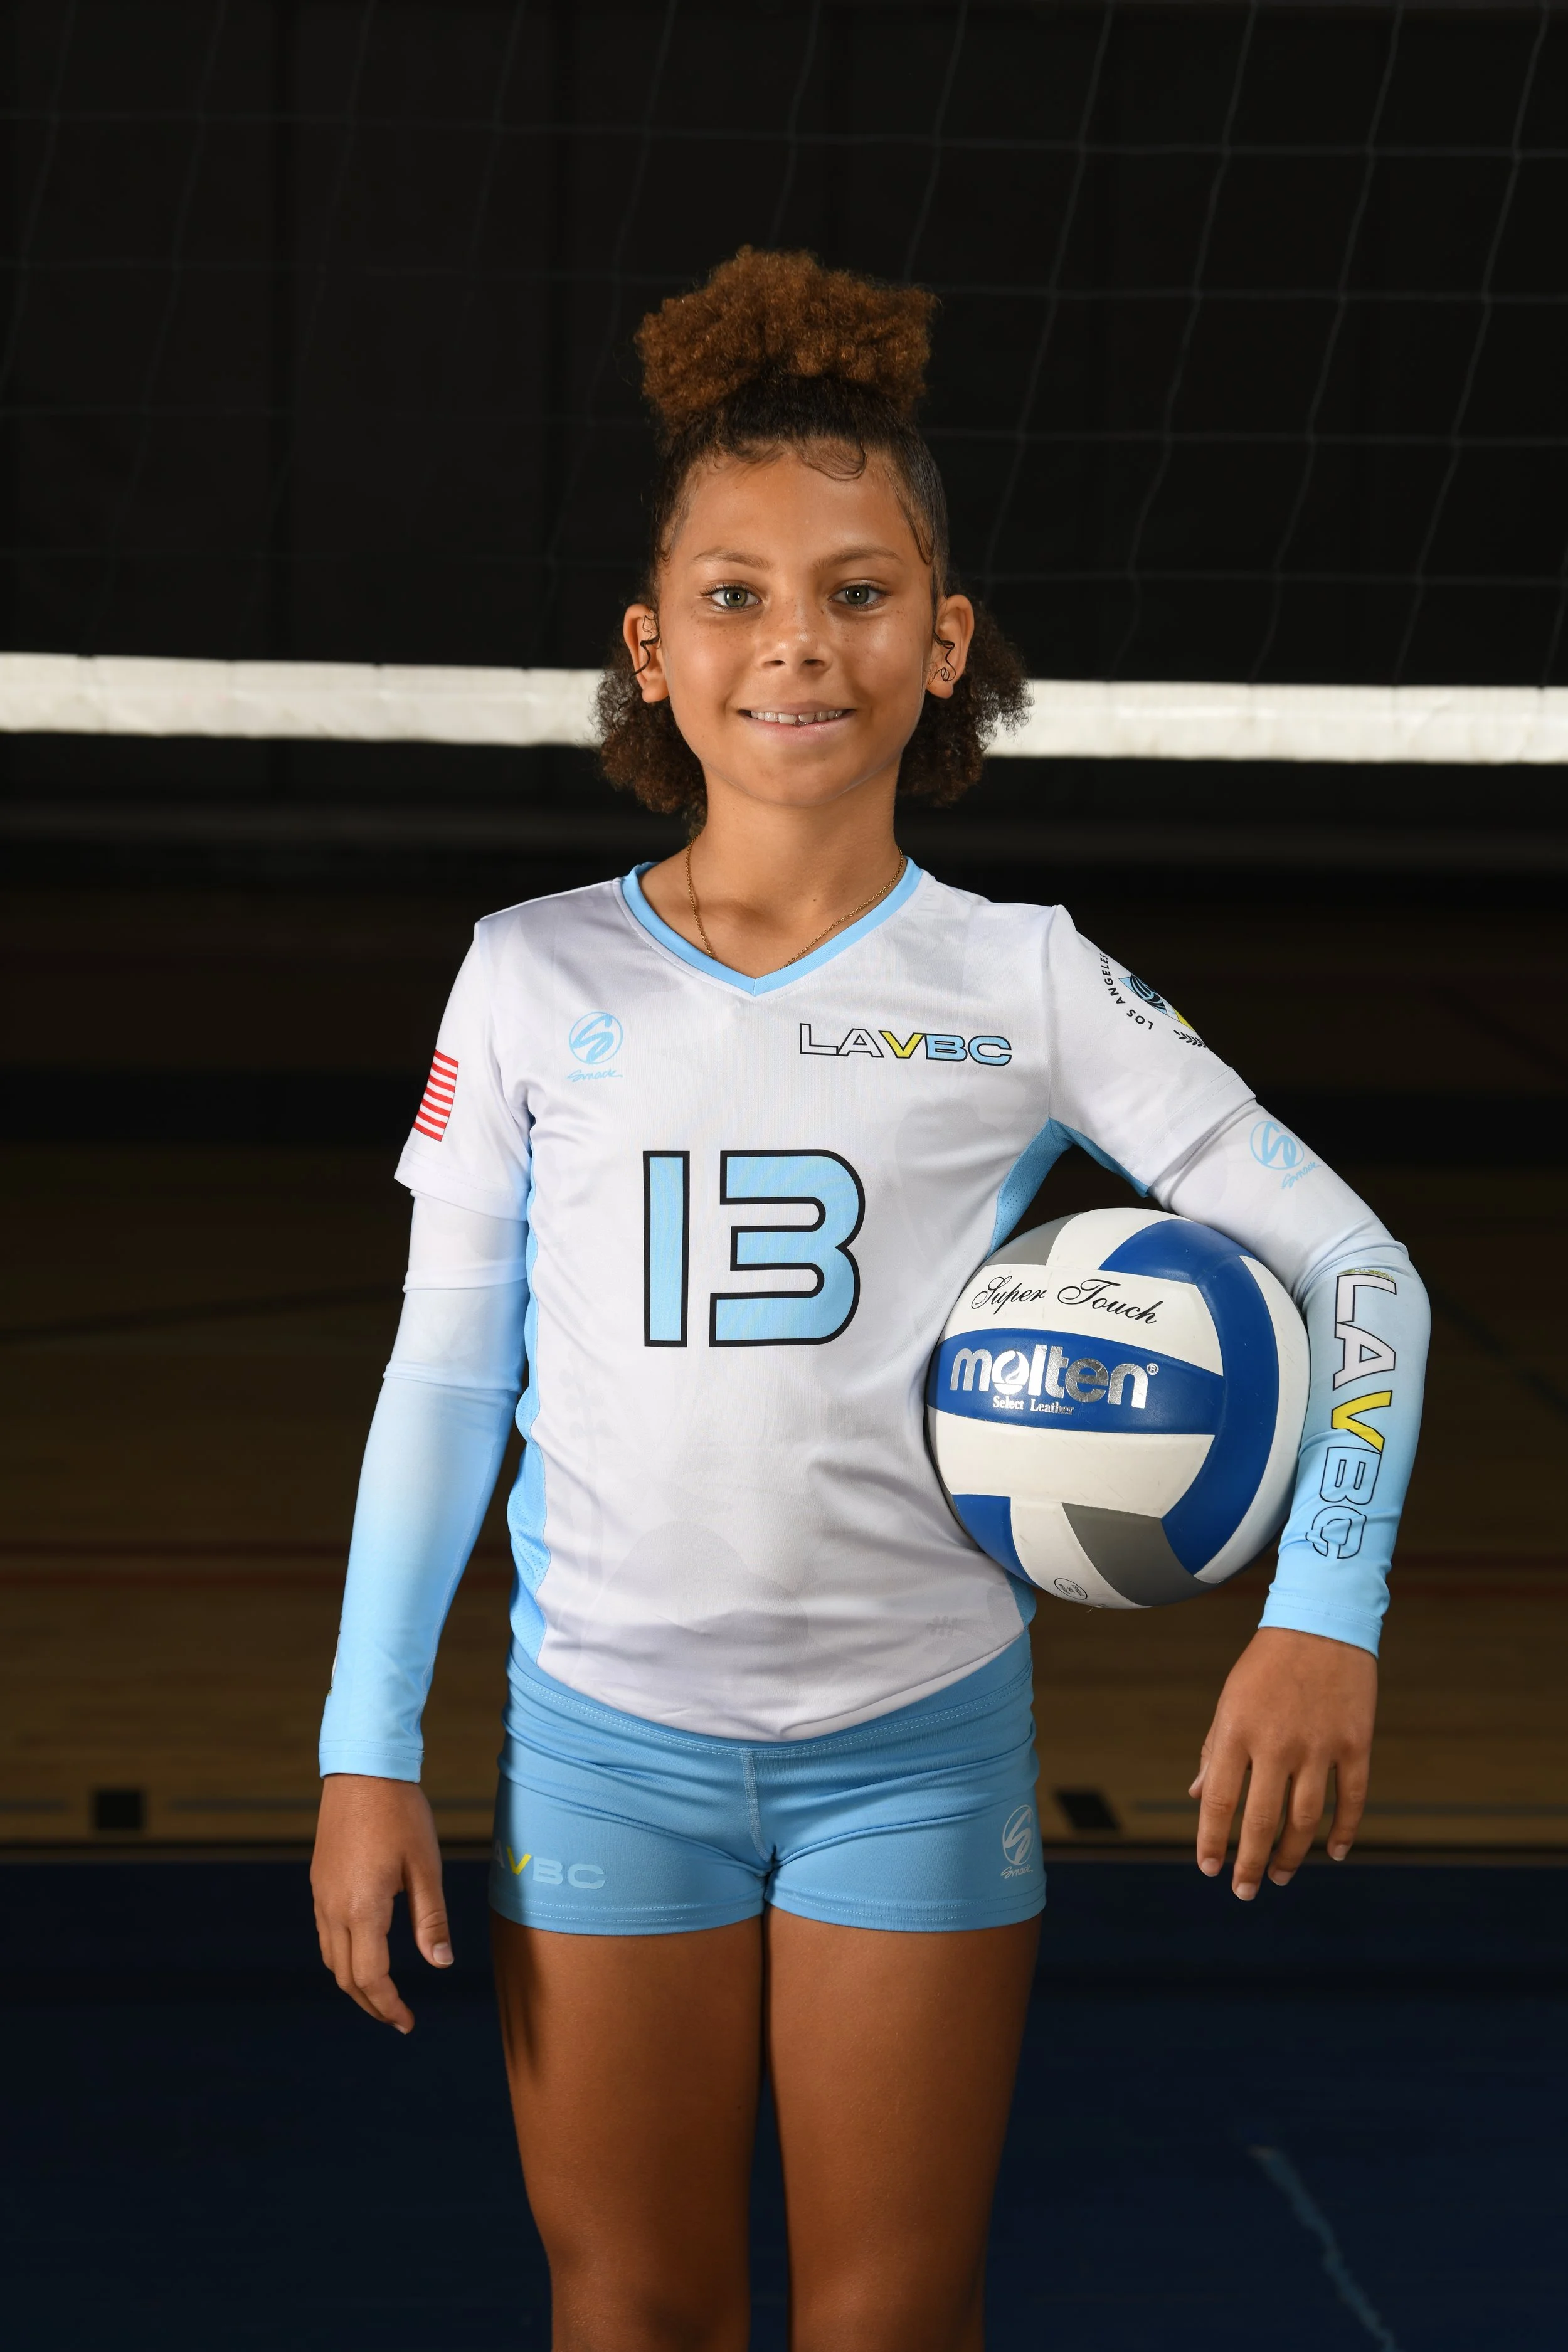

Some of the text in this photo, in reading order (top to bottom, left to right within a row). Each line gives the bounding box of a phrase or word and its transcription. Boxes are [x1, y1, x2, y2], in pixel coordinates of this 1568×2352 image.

[1099, 953, 1154, 1030] LOS ANGELES
[799, 1022, 1012, 1067] LAVBC
[642, 1149, 866, 1348] 13
[971, 1276, 1164, 1325] Super Touch
[992, 1395, 1075, 1416] Select Leather
[1306, 1274, 1397, 1559] LAVBC
